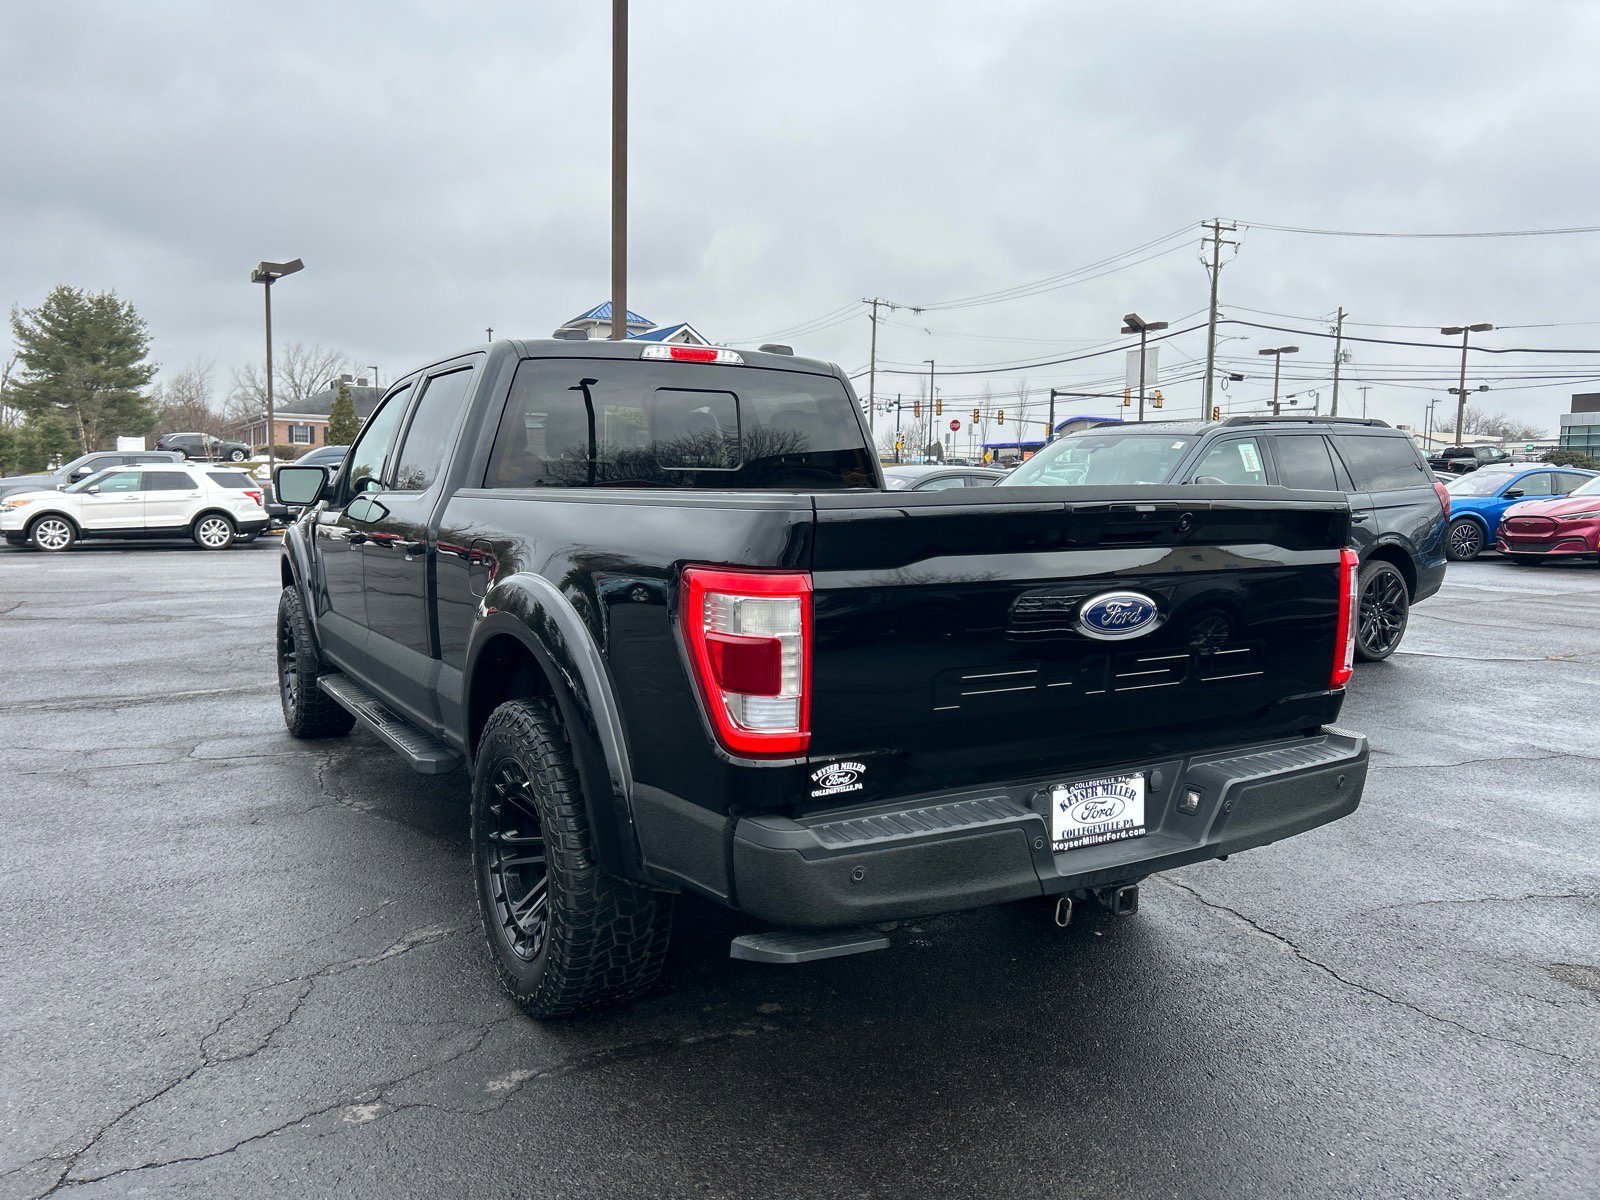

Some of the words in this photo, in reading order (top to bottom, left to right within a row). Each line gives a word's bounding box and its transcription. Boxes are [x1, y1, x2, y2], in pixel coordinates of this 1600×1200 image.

[1101, 601, 1142, 626] Ford
[811, 763, 840, 782] KEYSER
[841, 762, 866, 773] MILLER
[825, 772, 851, 786] Ford
[1060, 786, 1098, 812] KEYSER
[1101, 783, 1137, 802] MILLER
[1081, 799, 1116, 821] Ford
[1052, 827, 1146, 851] KeyserMillerFord.com
